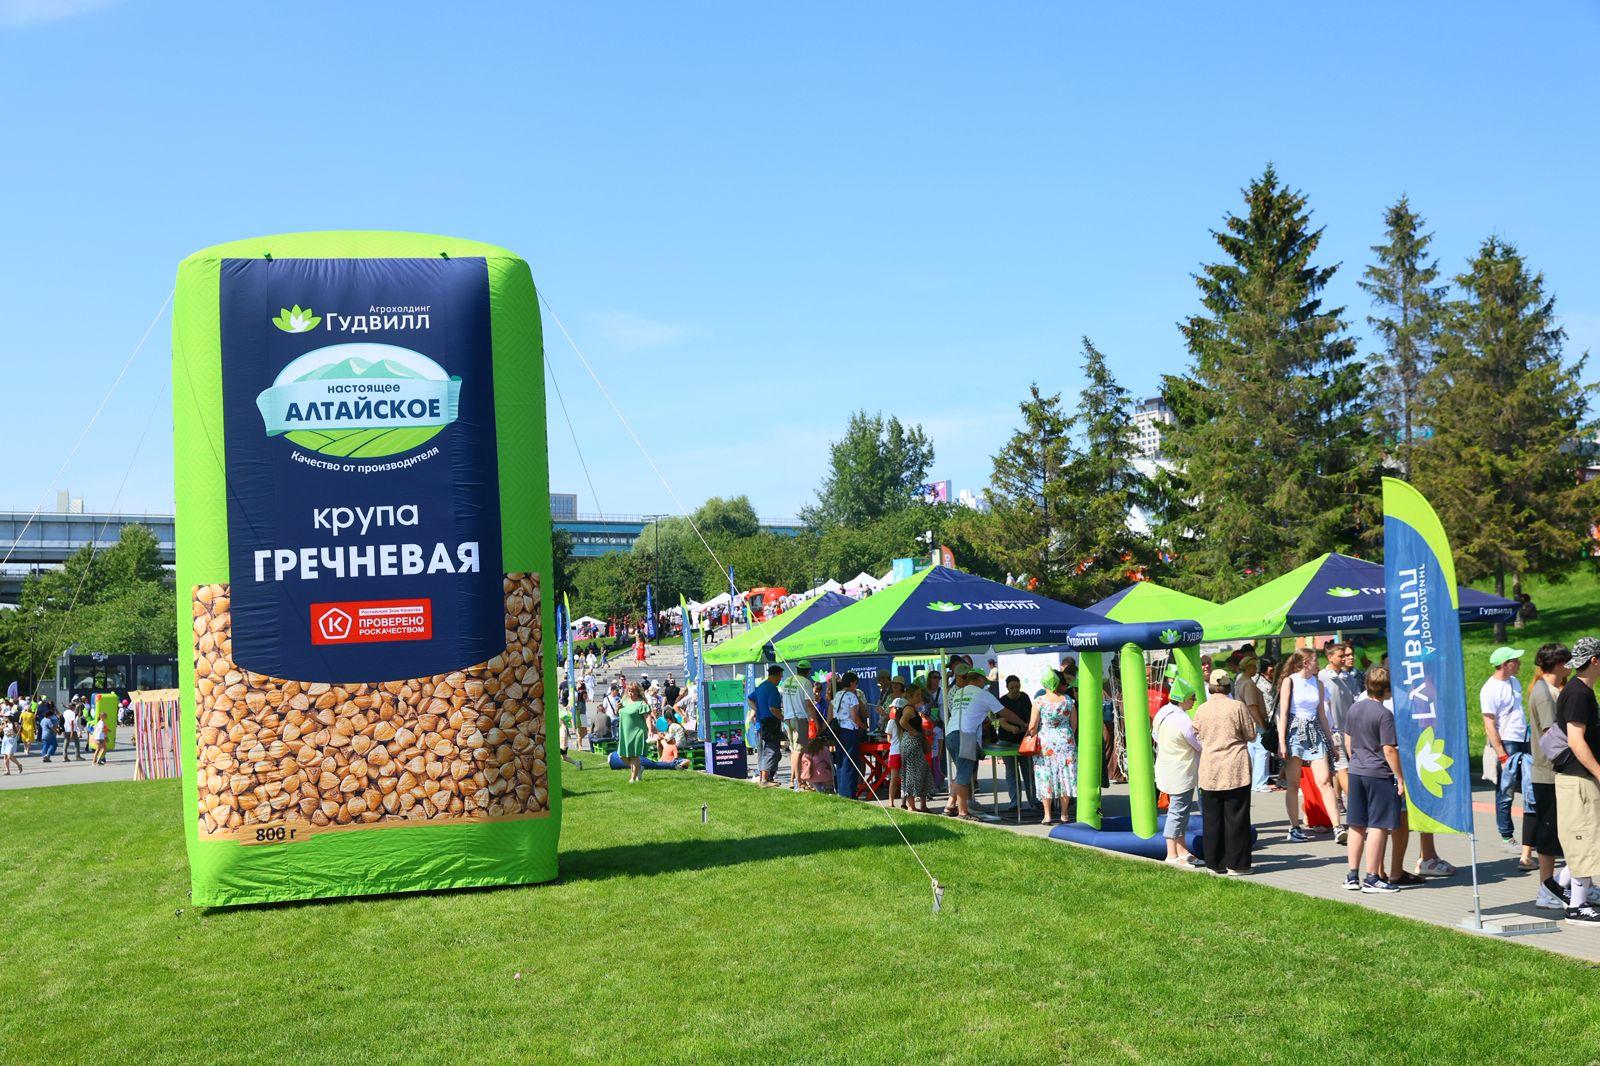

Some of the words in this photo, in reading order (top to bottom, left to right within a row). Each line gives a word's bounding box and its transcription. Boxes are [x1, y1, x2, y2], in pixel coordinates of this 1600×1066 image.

[369, 304, 431, 314] Агрохолдинг
[326, 313, 430, 333] Гудвилл
[327, 383, 401, 394] настоящее
[285, 397, 441, 421] АЛТАЙСКОЕ
[291, 450, 341, 472] Качество
[343, 463, 355, 472] от
[358, 446, 440, 474] производителя
[313, 503, 419, 536] крупа
[253, 541, 480, 582] ГРЕЧНЕВАЯ
[963, 602, 1040, 611] Гудвилл
[359, 616, 424, 627] ПРОВЕРЕНО
[1328, 614, 1363, 624] Гудвилл
[359, 626, 425, 636] РОСКАЧЕСТВОМ
[925, 631, 962, 641] Гудвилл
[1005, 627, 1042, 637] Гудвилл
[256, 827, 285, 841] 800
[290, 829, 297, 839] г
